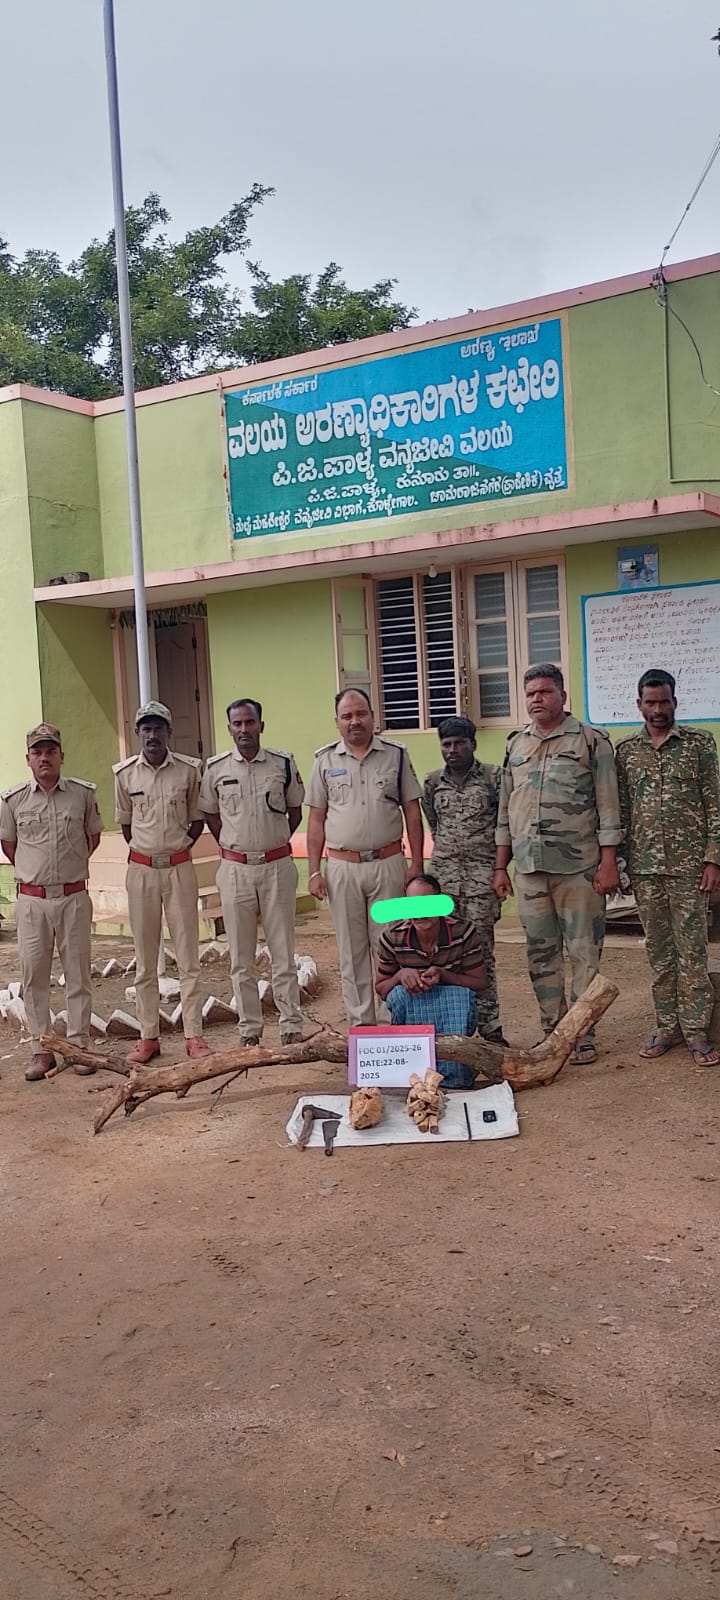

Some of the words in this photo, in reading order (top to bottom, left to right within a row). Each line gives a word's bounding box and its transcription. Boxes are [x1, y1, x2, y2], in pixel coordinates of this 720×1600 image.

[460, 337, 496, 361] ಅರಣ್ಯ
[499, 324, 540, 351] ಇಲಾಖೆ
[242, 382, 282, 406] ಕರ್ನಾಟಕ
[284, 374, 318, 398] ಸರ್ಕಾರ
[228, 412, 287, 459] ವಲಯ
[295, 369, 480, 448] ಅರಣ್ಯಾಧಿಕಾರಿಗಳ
[485, 356, 560, 413] ಕಛೇರಿ
[459, 420, 513, 455] ವಲಯ
[396, 466, 450, 490] ಹನೂರು
[359, 1047, 375, 1055] FOC
[376, 1044, 422, 1054] 01/2025-26
[360, 1072, 380, 1080] 2025
